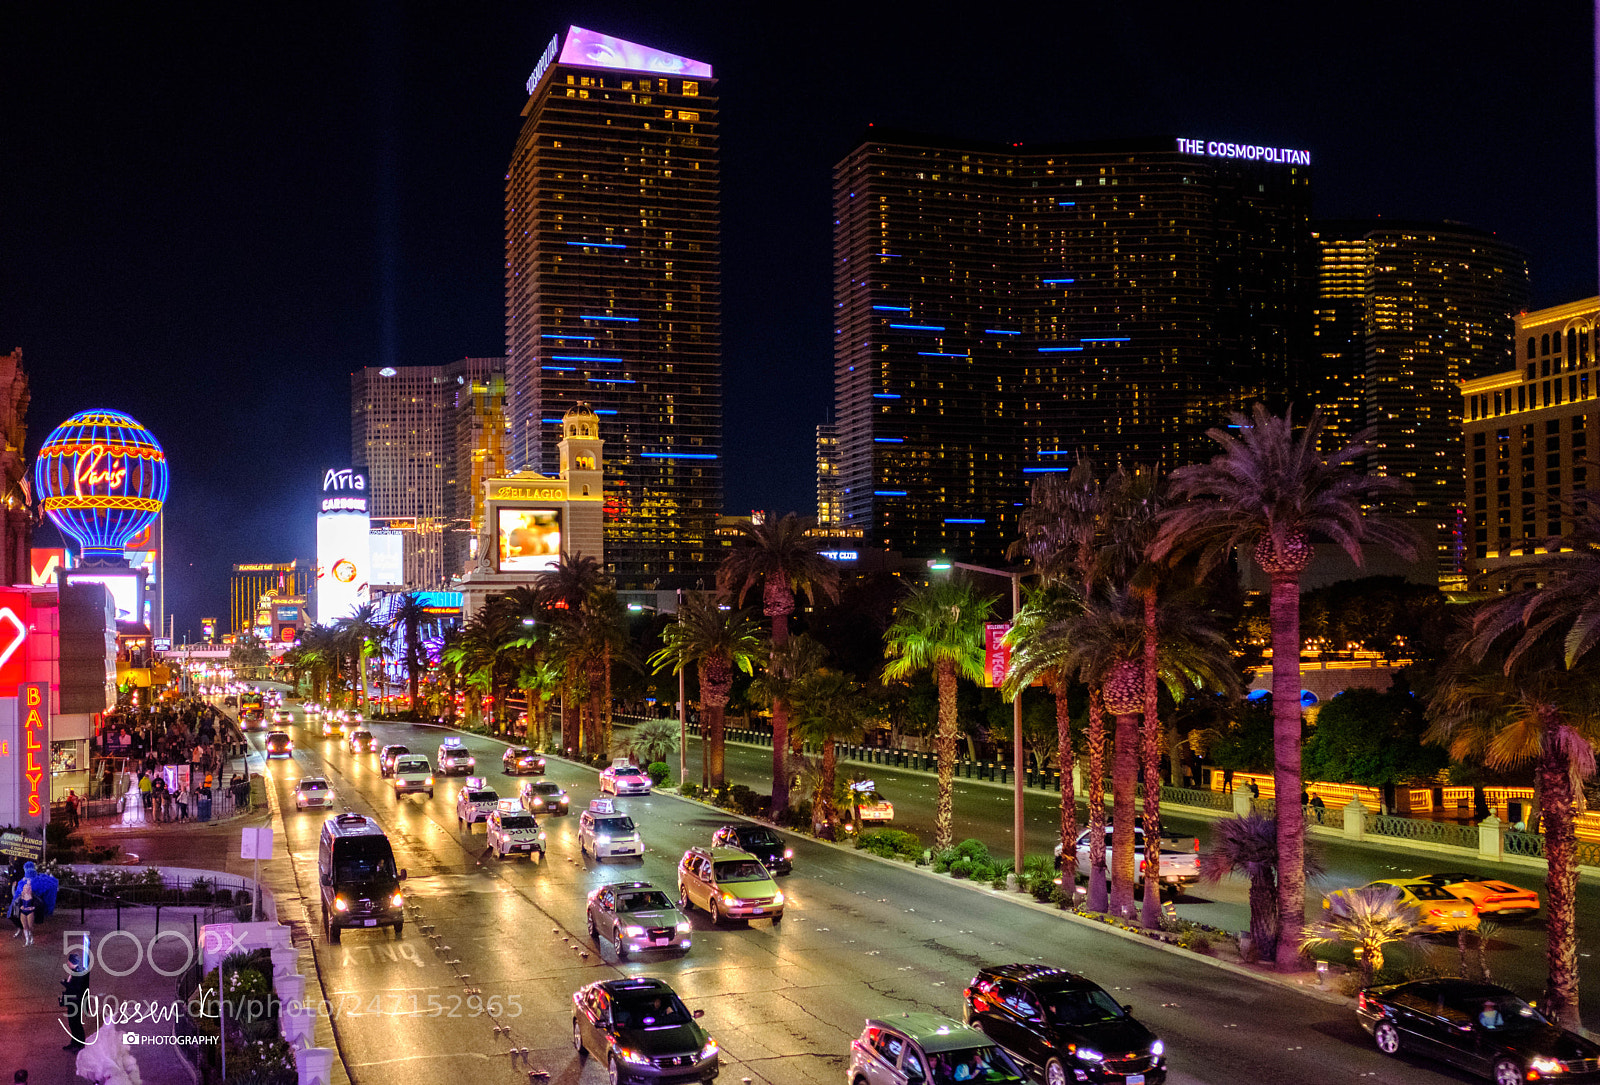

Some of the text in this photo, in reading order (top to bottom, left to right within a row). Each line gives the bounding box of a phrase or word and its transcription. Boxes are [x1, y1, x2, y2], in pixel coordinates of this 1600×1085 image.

[1176, 138, 1311, 166] THE COSMOPOLITAN
[74, 443, 127, 501] Paris
[323, 468, 365, 491] Aria
[498, 486, 563, 499] BELLAGIO
[839, 551, 858, 560] CLUB
[992, 631, 1005, 685] LAS VEGAS
[24, 837, 43, 845] KINGS
